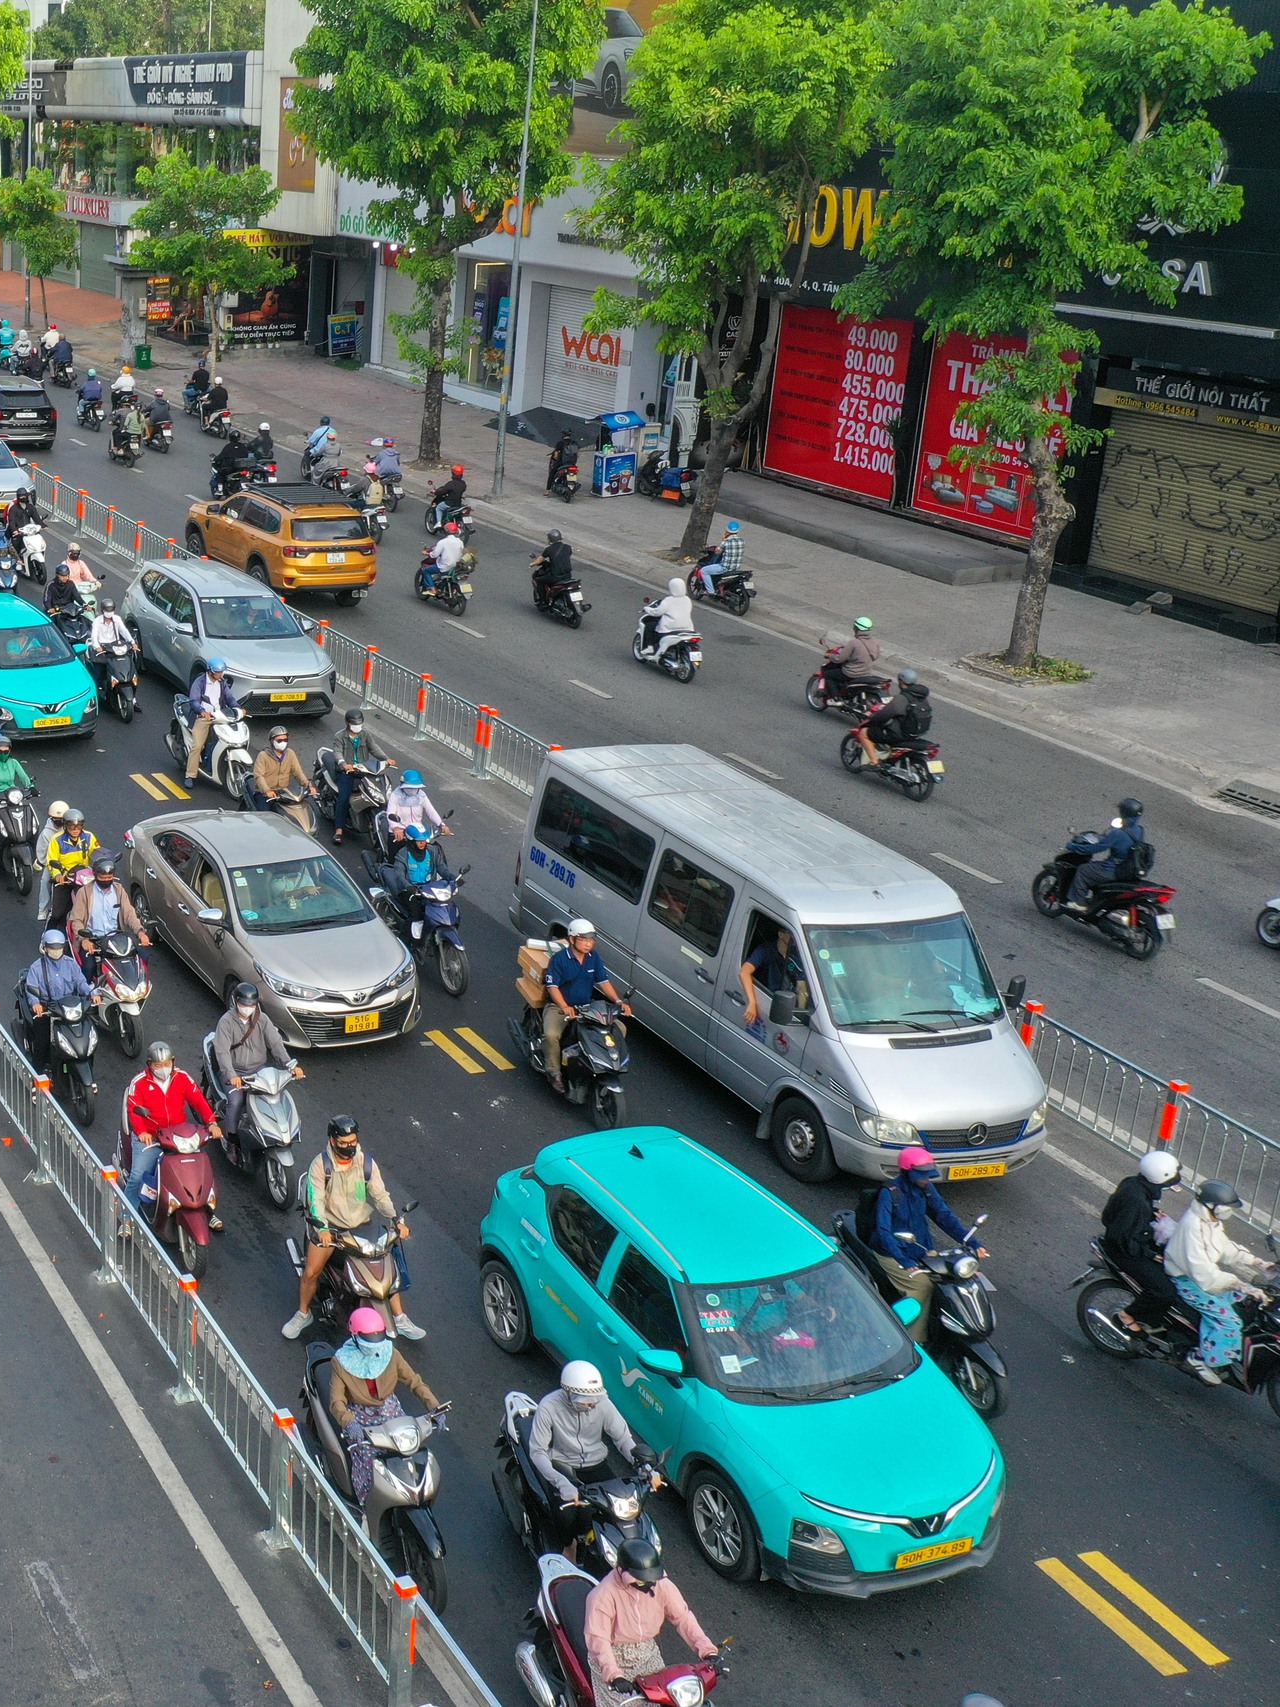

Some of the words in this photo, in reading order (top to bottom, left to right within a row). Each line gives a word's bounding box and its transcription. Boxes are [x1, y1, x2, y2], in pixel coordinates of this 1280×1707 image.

[71, 197, 111, 218] LUXURY
[340, 206, 352, 233] ĐỒ
[353, 206, 364, 234] GỖ
[249, 233, 266, 243] HÁT
[847, 325, 898, 353] 49.000
[971, 342, 995, 359] TRẢ
[844, 349, 895, 377] 80.000
[842, 373, 905, 404] 455.000
[1135, 375, 1166, 395] THẾ
[1166, 380, 1196, 401] GIỚI
[1199, 386, 1224, 407] NỘI
[1229, 390, 1271, 412] THẤT
[1115, 395, 1144, 409] Hotline:
[1145, 401, 1196, 417] 0966.545484
[549, 859, 576, 889] 289.76
[348, 1021, 375, 1032] 819.81
[355, 1014, 369, 1024] 51G
[953, 1165, 1001, 1178] 60H-289.76
[701, 1310, 730, 1319] TAXI
[902, 1541, 966, 1566] 50H-374.89
